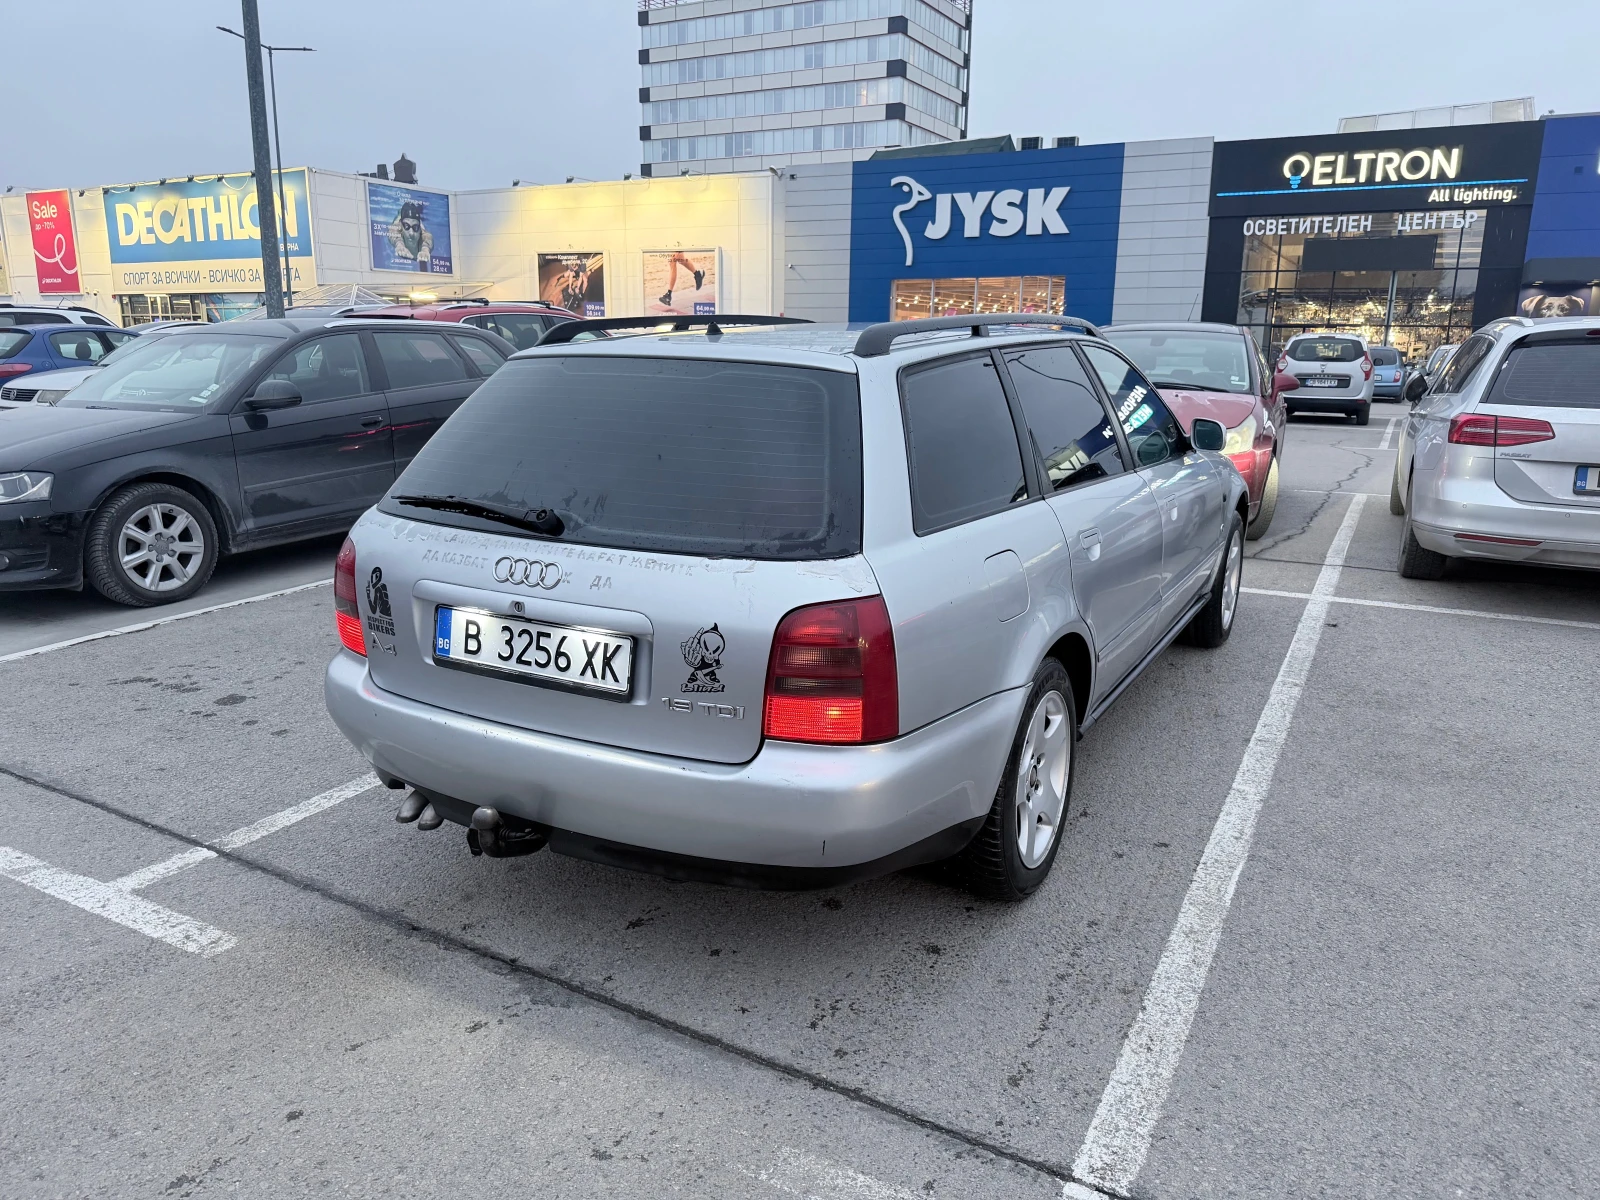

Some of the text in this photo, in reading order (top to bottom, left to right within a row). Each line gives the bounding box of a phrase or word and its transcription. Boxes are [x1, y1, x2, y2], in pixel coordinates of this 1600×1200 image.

[1428, 189, 1450, 203] All
[32, 200, 58, 219] Sale
[924, 186, 1071, 240] JYSK
[115, 191, 298, 246] DECATHLON
[1243, 210, 1478, 236] ОСВЕТИТЕЛЕН ЦЕНТЪР
[280, 243, 299, 251] ВРНА
[124, 272, 150, 285] СПОРТ
[152, 272, 163, 284] ЗА
[165, 270, 201, 284] ВСИЧКИ
[209, 269, 246, 283] ВСИЧКО
[248, 268, 261, 282] ЗА
[368, 622, 396, 636] BIKERS
[438, 637, 449, 649] BG
[464, 618, 623, 683] B 3256 XK
[681, 683, 725, 693] blind
[697, 702, 745, 720] TDI
